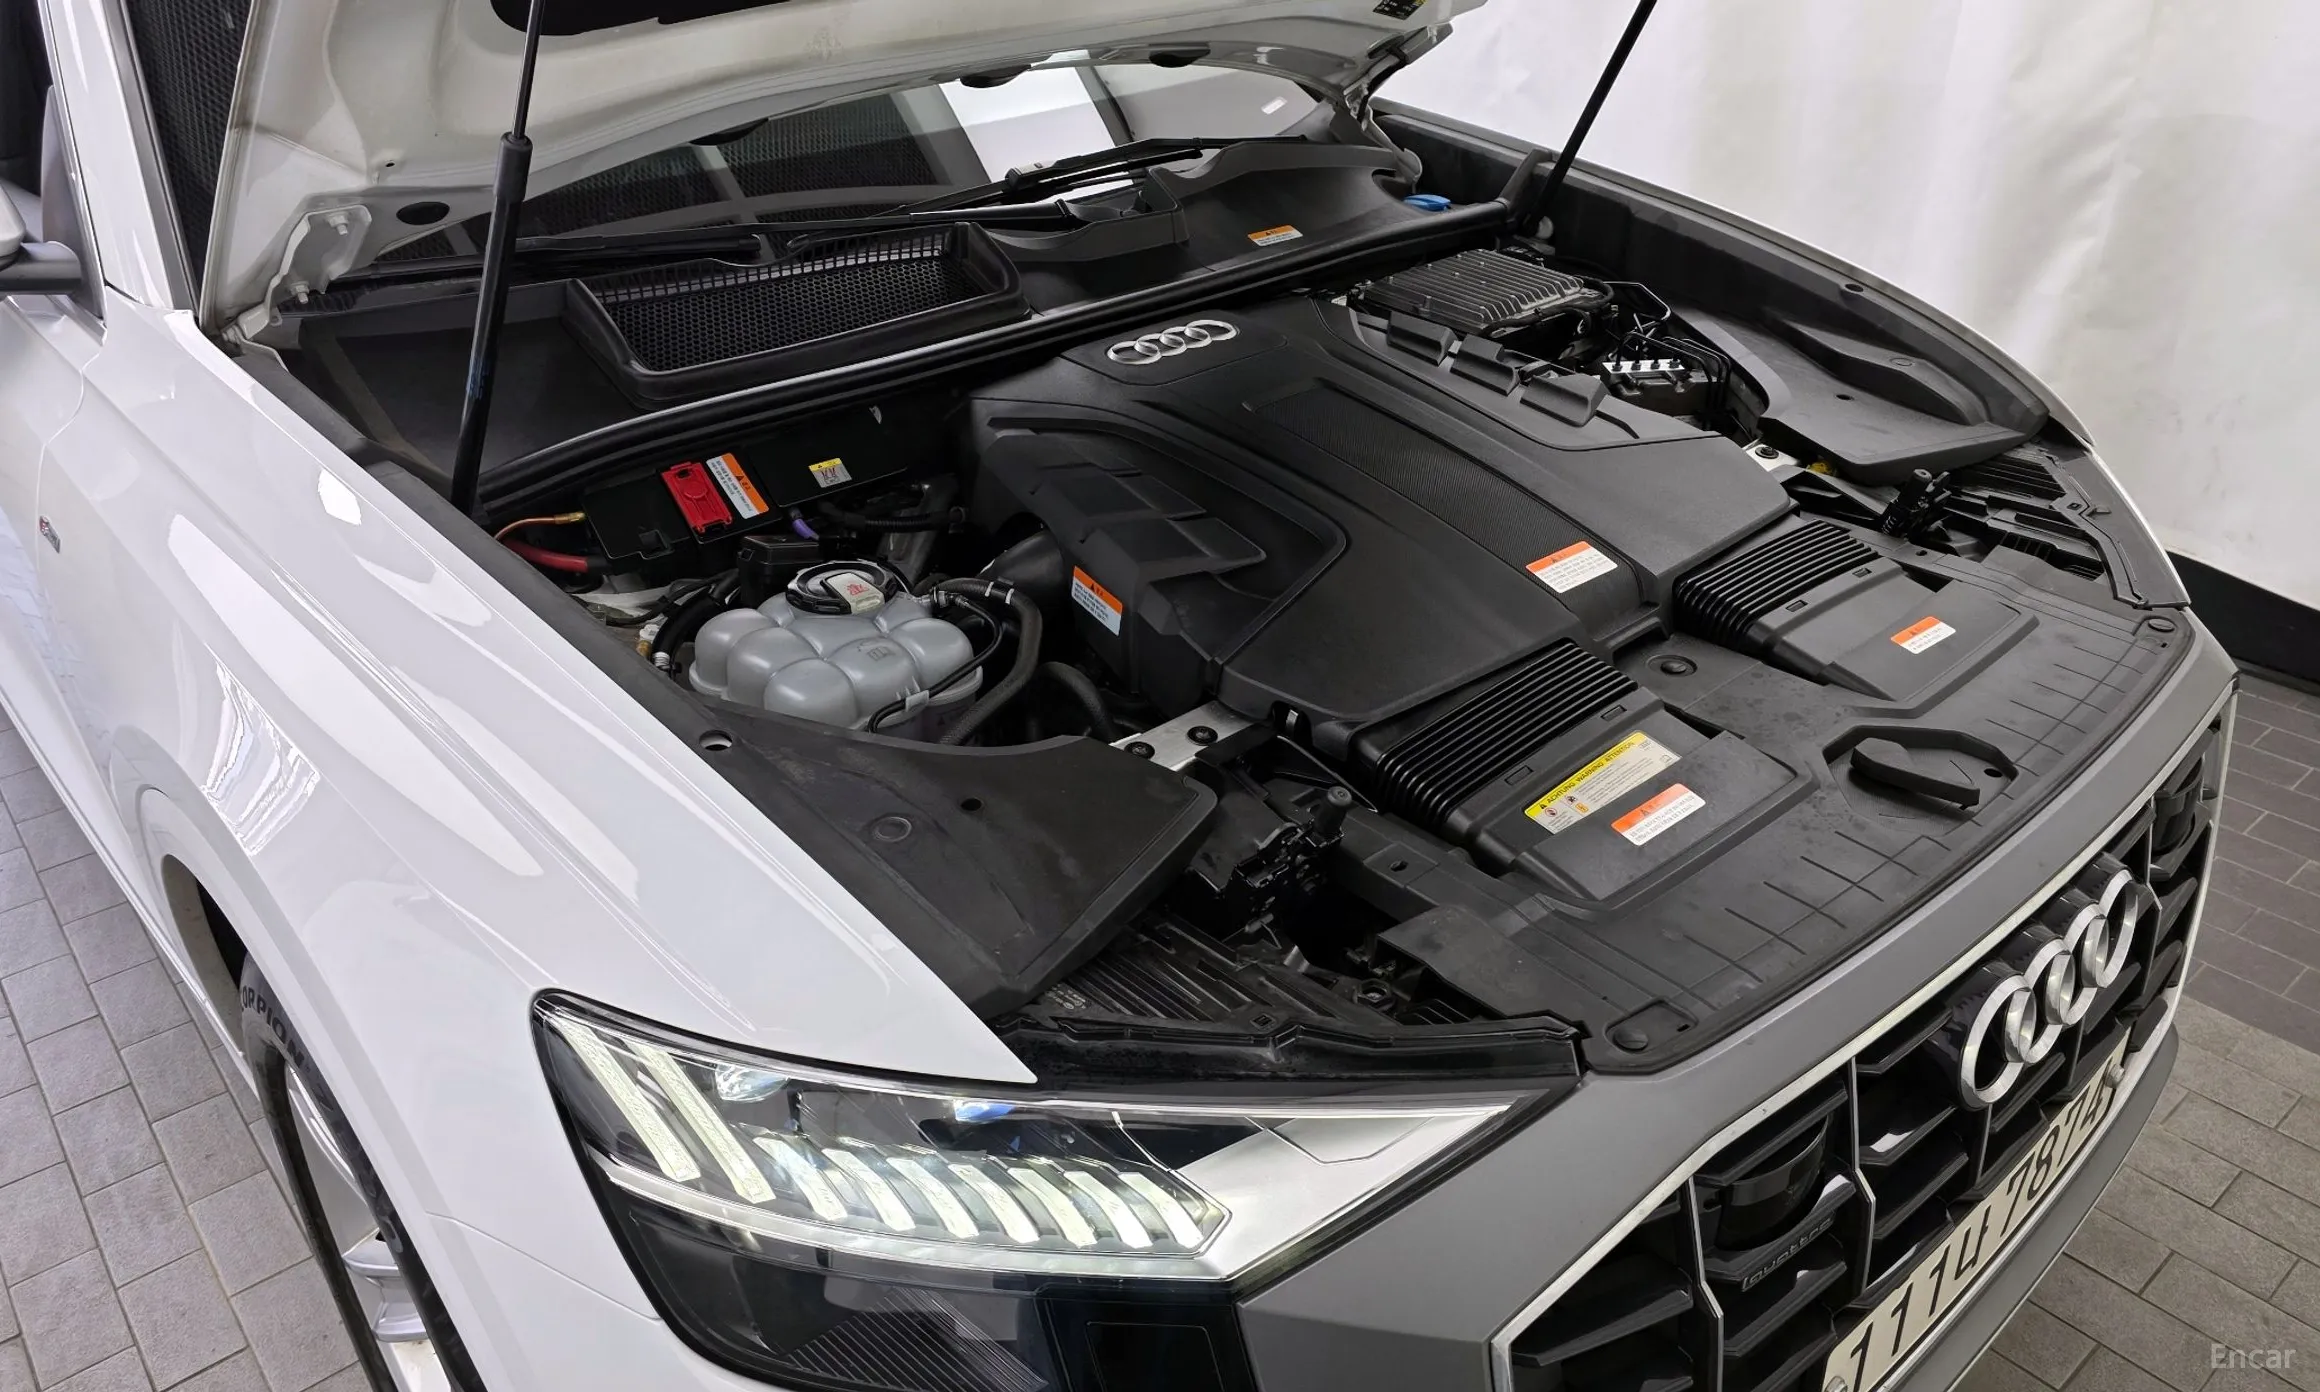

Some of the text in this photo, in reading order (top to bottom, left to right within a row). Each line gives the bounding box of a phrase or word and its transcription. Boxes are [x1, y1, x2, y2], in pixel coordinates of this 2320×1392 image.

[1546, 781, 1576, 804] ACHTUNG
[1575, 762, 1604, 783] WARNING
[1605, 741, 1635, 762] ATTENTION
[241, 985, 305, 1068] ORPION
[2000, 1055, 2114, 1238] 7874
[1749, 1217, 1831, 1284] quattro
